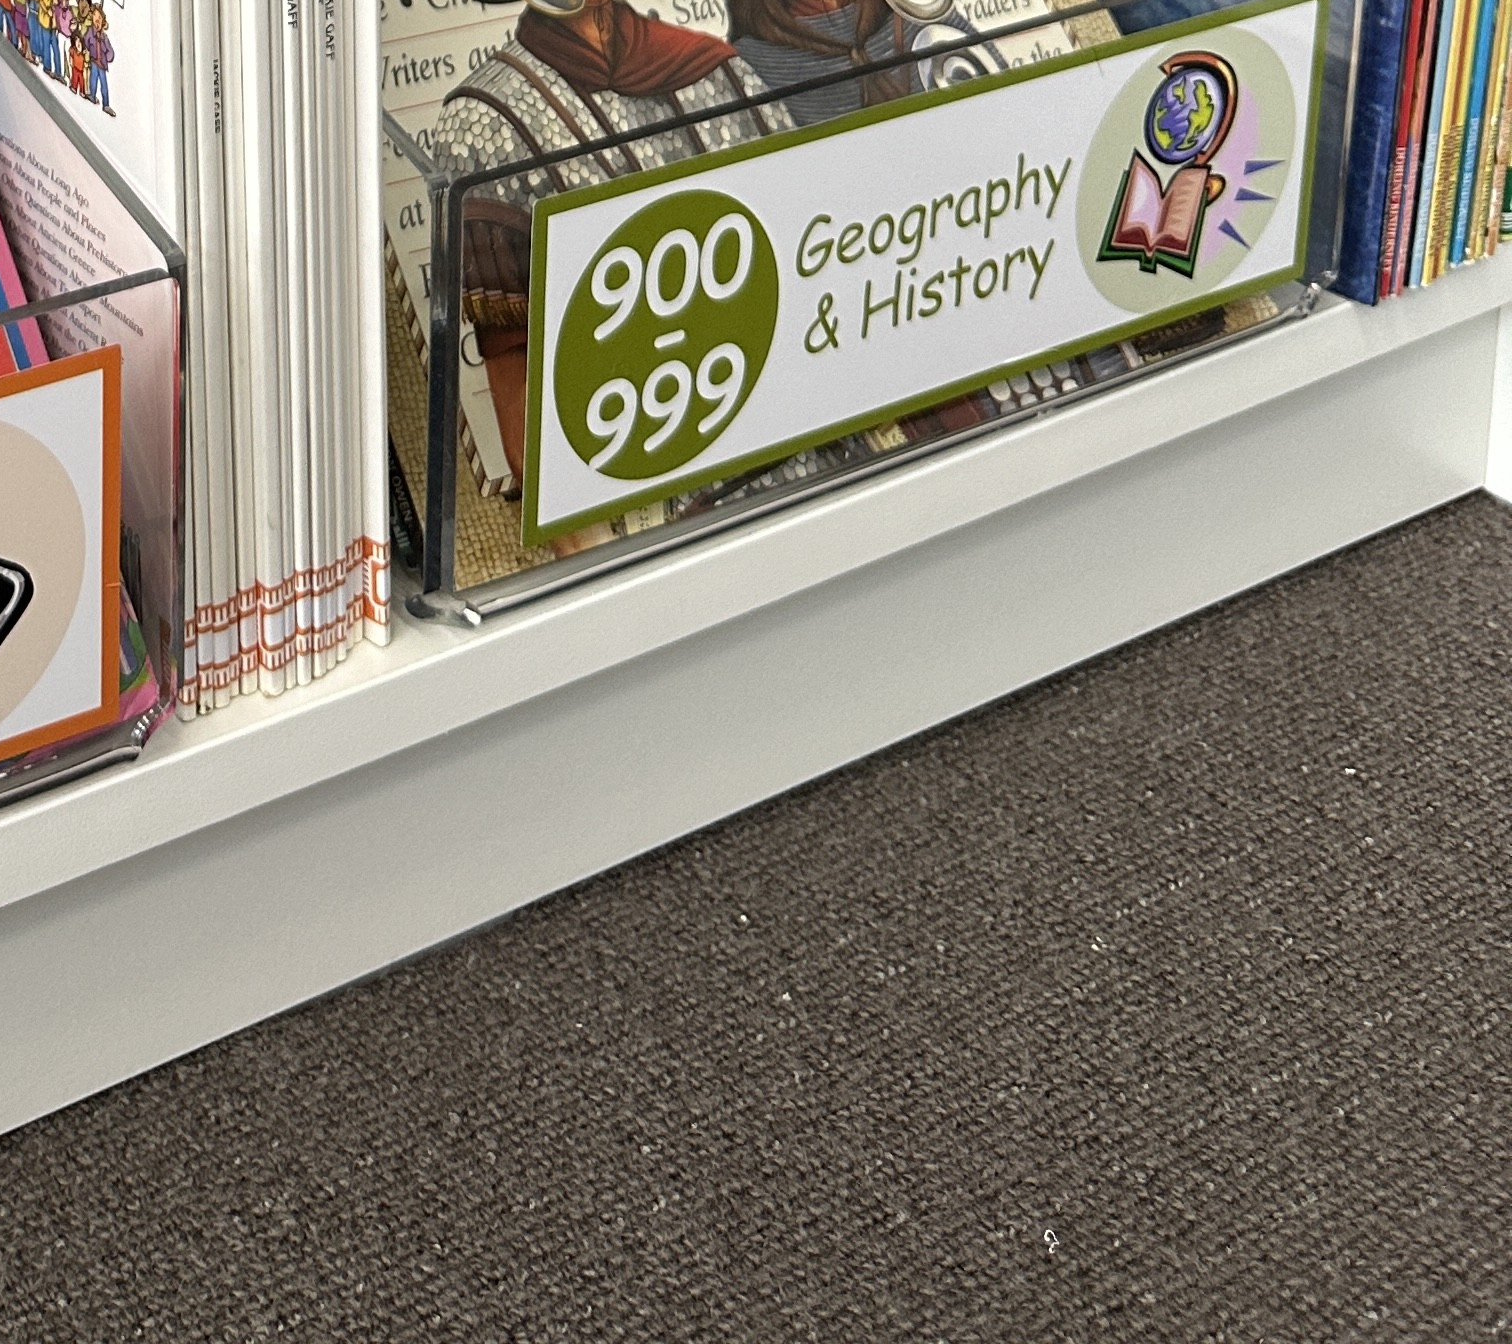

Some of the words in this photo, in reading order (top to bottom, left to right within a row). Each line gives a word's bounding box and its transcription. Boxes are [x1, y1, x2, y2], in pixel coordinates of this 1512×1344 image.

[590, 213, 754, 344] 900
[794, 152, 1073, 281] Geography
[804, 293, 839, 356] &
[861, 240, 1057, 340] History
[586, 342, 744, 472] 999
